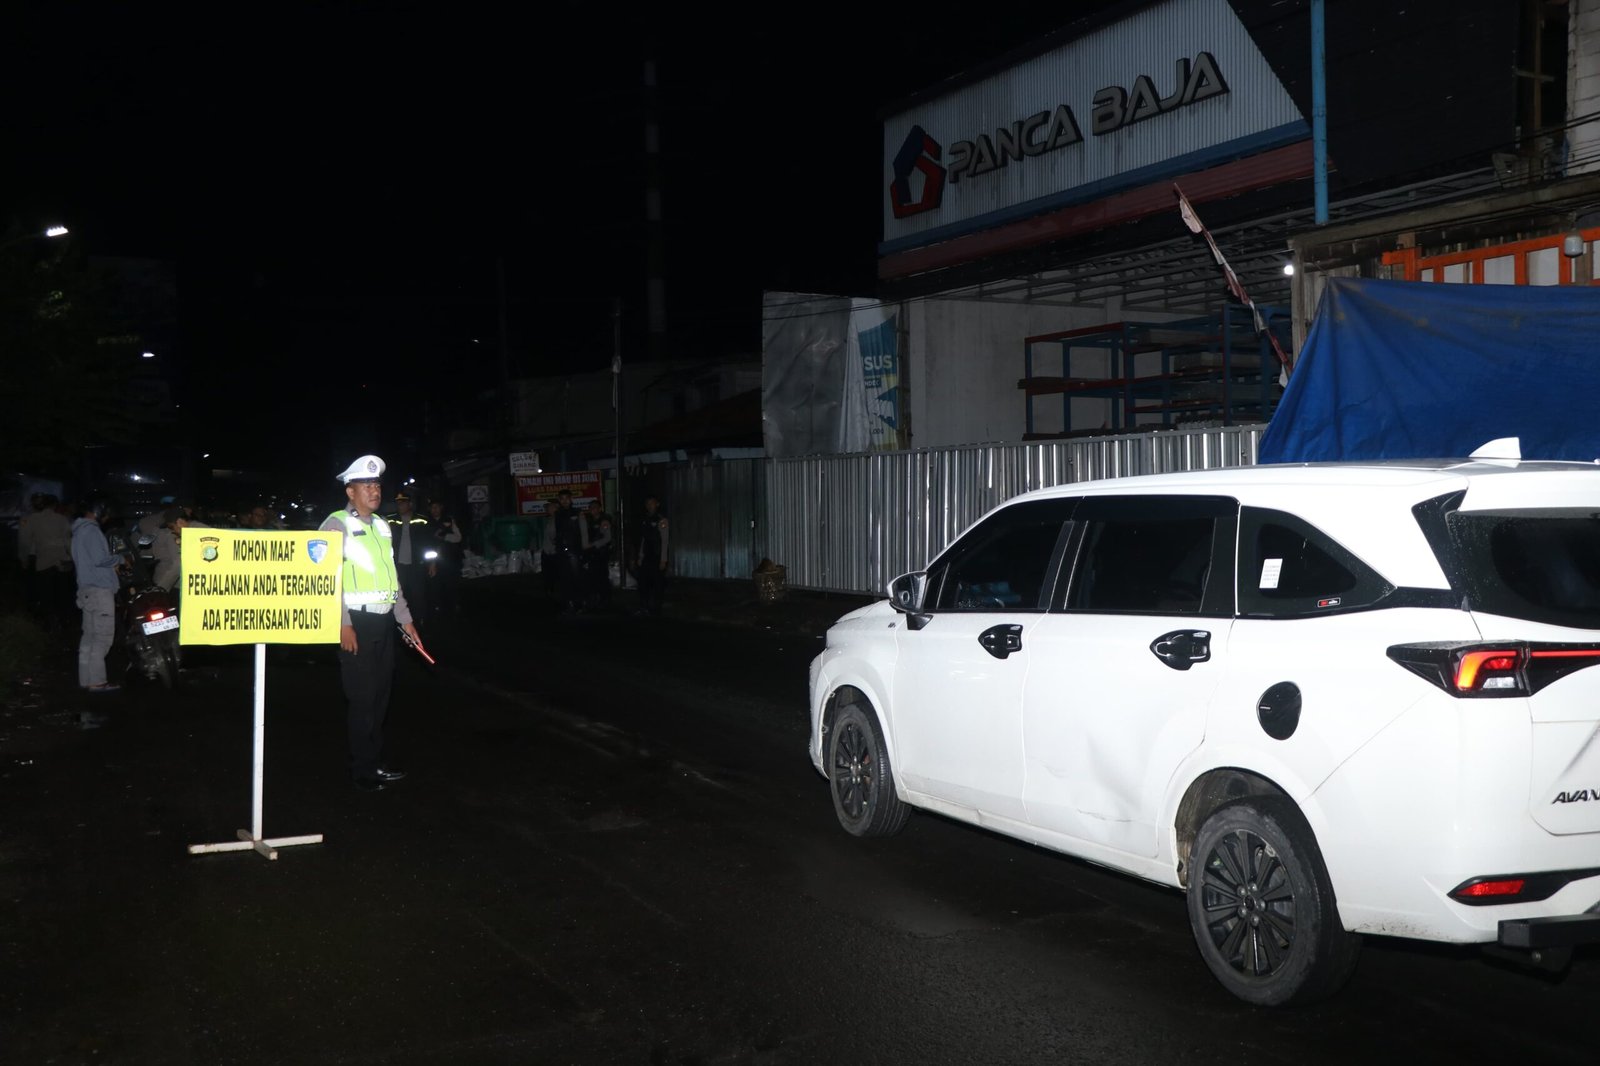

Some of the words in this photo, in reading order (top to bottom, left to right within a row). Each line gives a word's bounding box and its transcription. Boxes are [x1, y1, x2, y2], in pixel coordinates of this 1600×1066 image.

[948, 104, 1084, 183] PANCA
[1092, 51, 1230, 136] BAJA
[861, 354, 893, 371] SUS
[233, 540, 268, 561] MOHON
[270, 540, 295, 562] MAAF
[188, 574, 250, 596] PERJALANAN
[252, 574, 278, 596] ANDA
[280, 574, 336, 596] TERGANGGU
[202, 609, 221, 631] ADA
[224, 608, 290, 631] PEMERIKSAAN
[292, 608, 322, 630] POLISI
